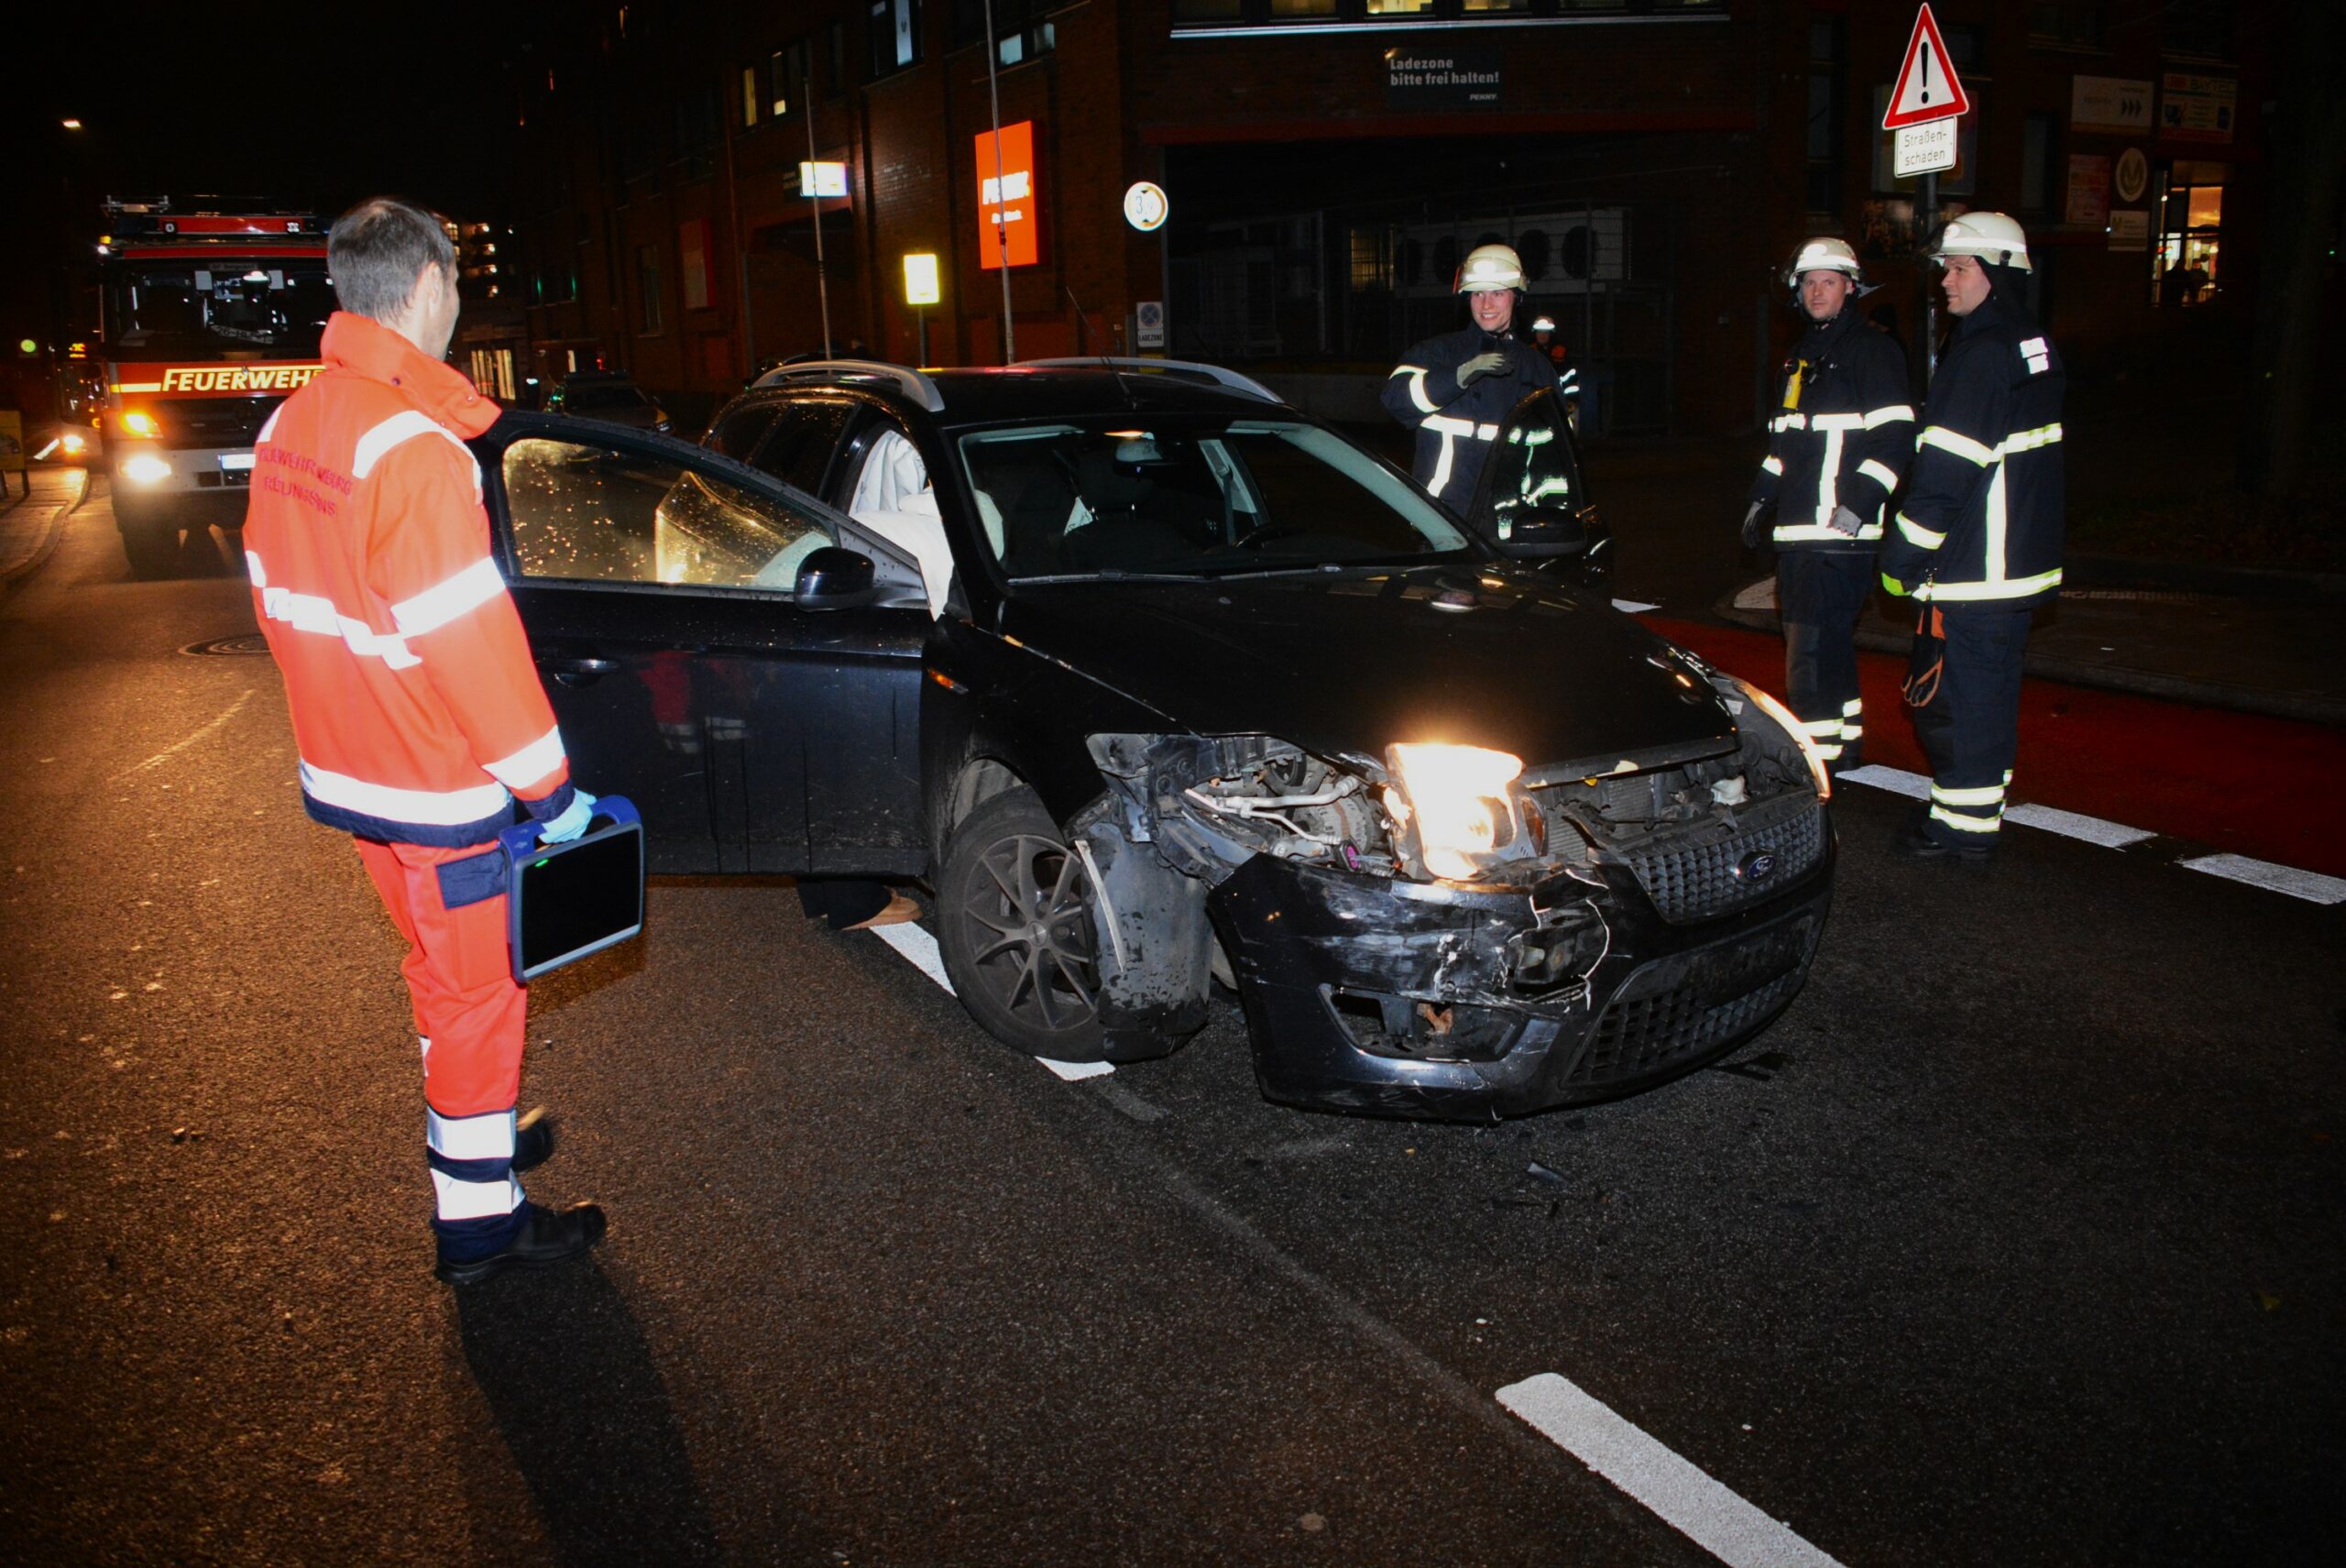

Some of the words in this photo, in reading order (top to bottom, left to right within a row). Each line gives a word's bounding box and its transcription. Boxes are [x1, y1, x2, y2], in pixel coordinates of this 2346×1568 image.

[1390, 57, 1453, 71] Ladezone
[1390, 72, 1423, 86] bitte
[1425, 71, 1449, 85] frei
[1451, 71, 1500, 84] halten!
[1903, 130, 1947, 148] Straßen-
[162, 365, 323, 391] FEUERWEH
